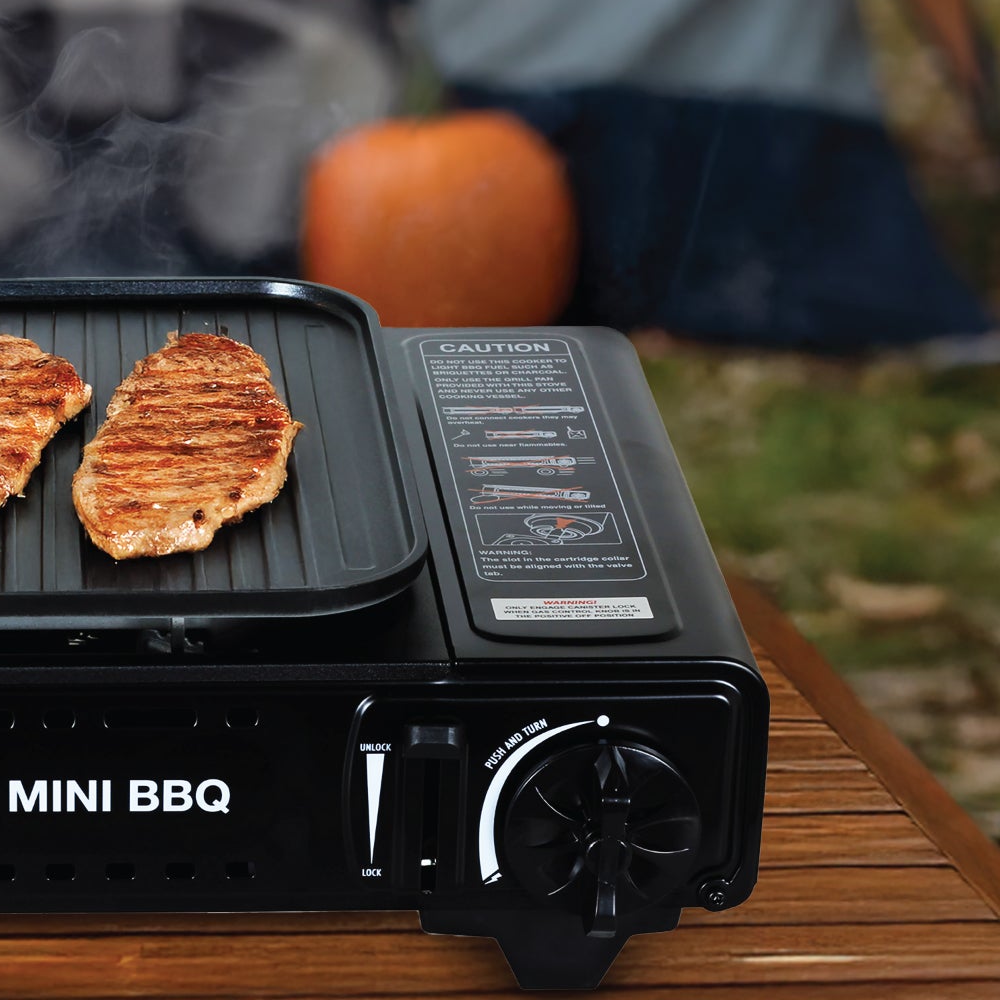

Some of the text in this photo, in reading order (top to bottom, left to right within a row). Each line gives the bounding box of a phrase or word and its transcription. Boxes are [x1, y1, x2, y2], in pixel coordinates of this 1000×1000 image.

[440, 343, 550, 352] CAUTION
[360, 743, 391, 752] UNLOCK
[484, 718, 548, 770] PUSH AND TURN
[9, 778, 231, 814] MINI BBQ
[361, 868, 382, 877] LOCK
